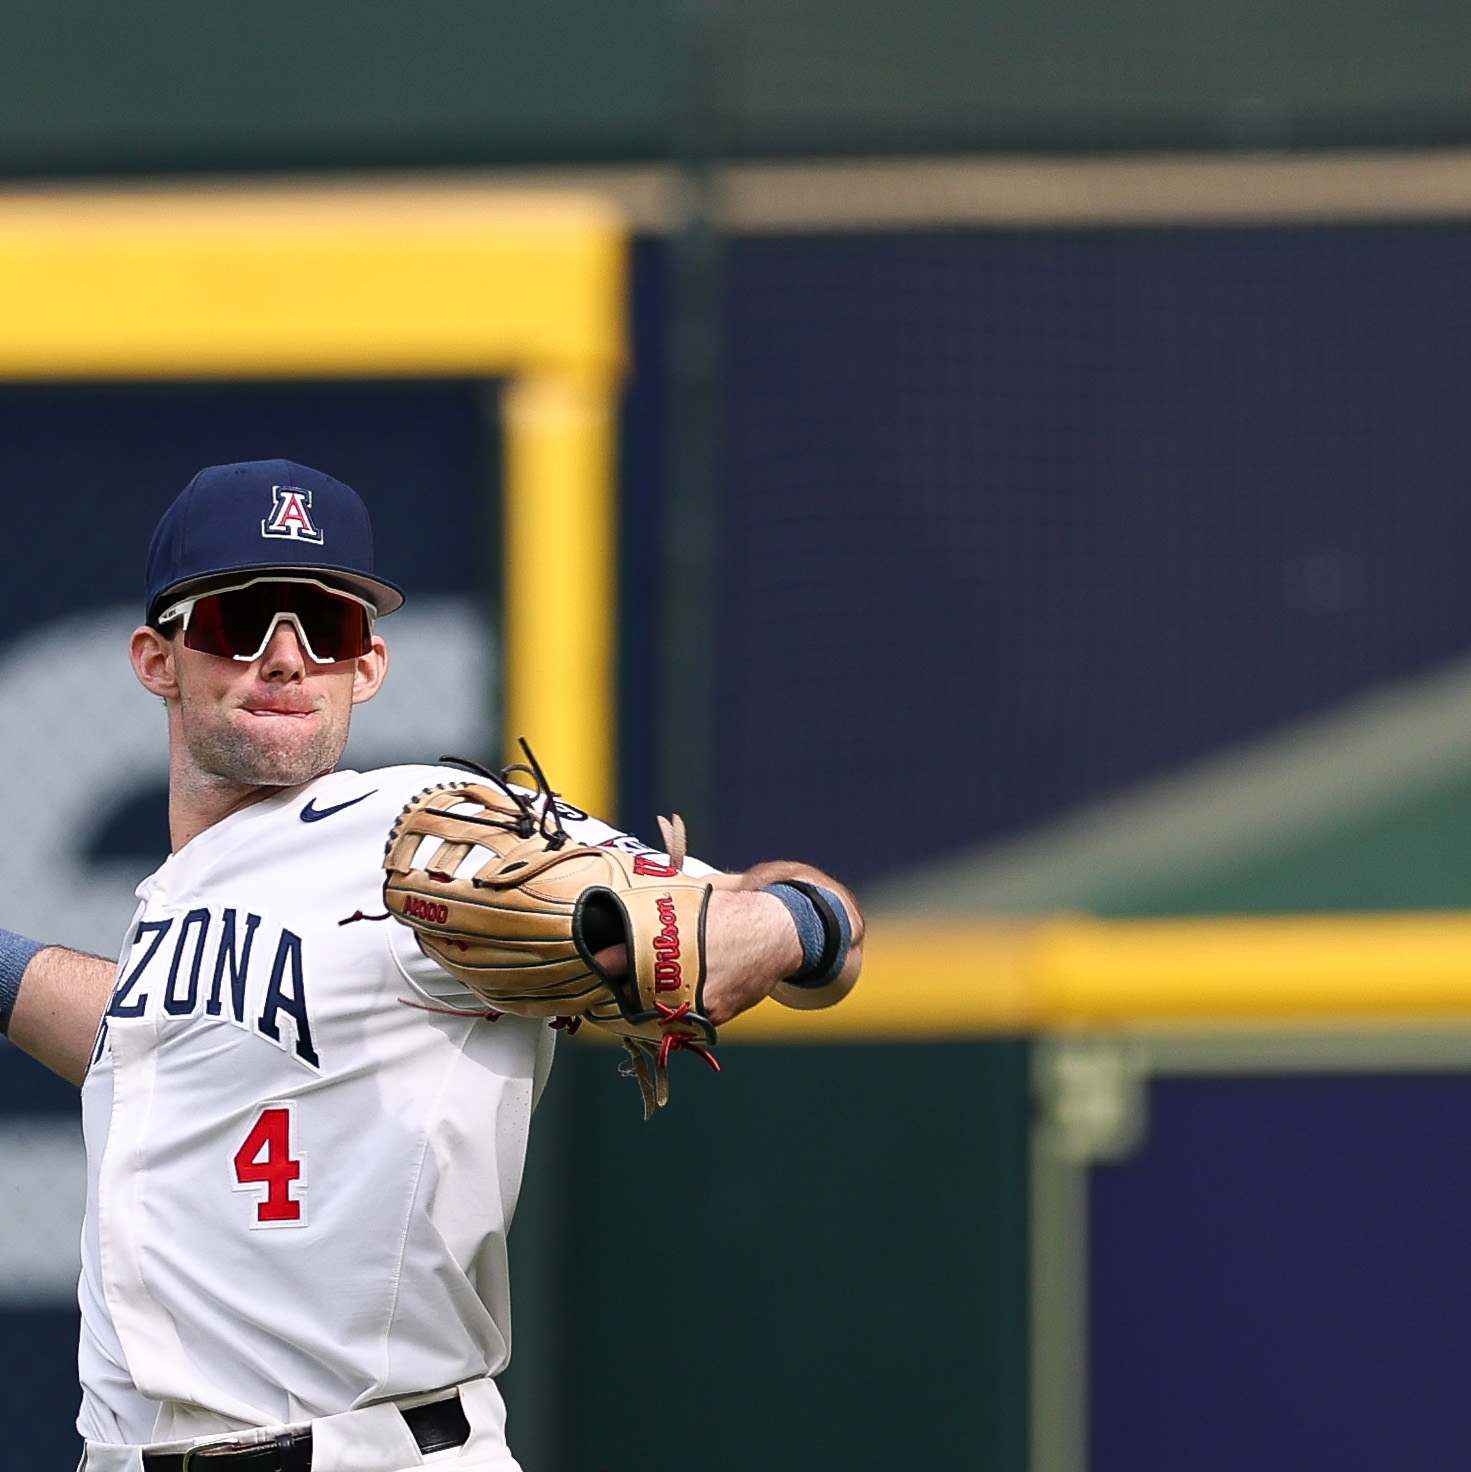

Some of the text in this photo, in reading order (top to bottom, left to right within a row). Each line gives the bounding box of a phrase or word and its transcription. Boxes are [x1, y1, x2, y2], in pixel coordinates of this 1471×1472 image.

[261, 485, 324, 545] A
[93, 906, 321, 1069] ZONA
[653, 896, 683, 994] Wilson
[232, 1106, 302, 1223] 4
